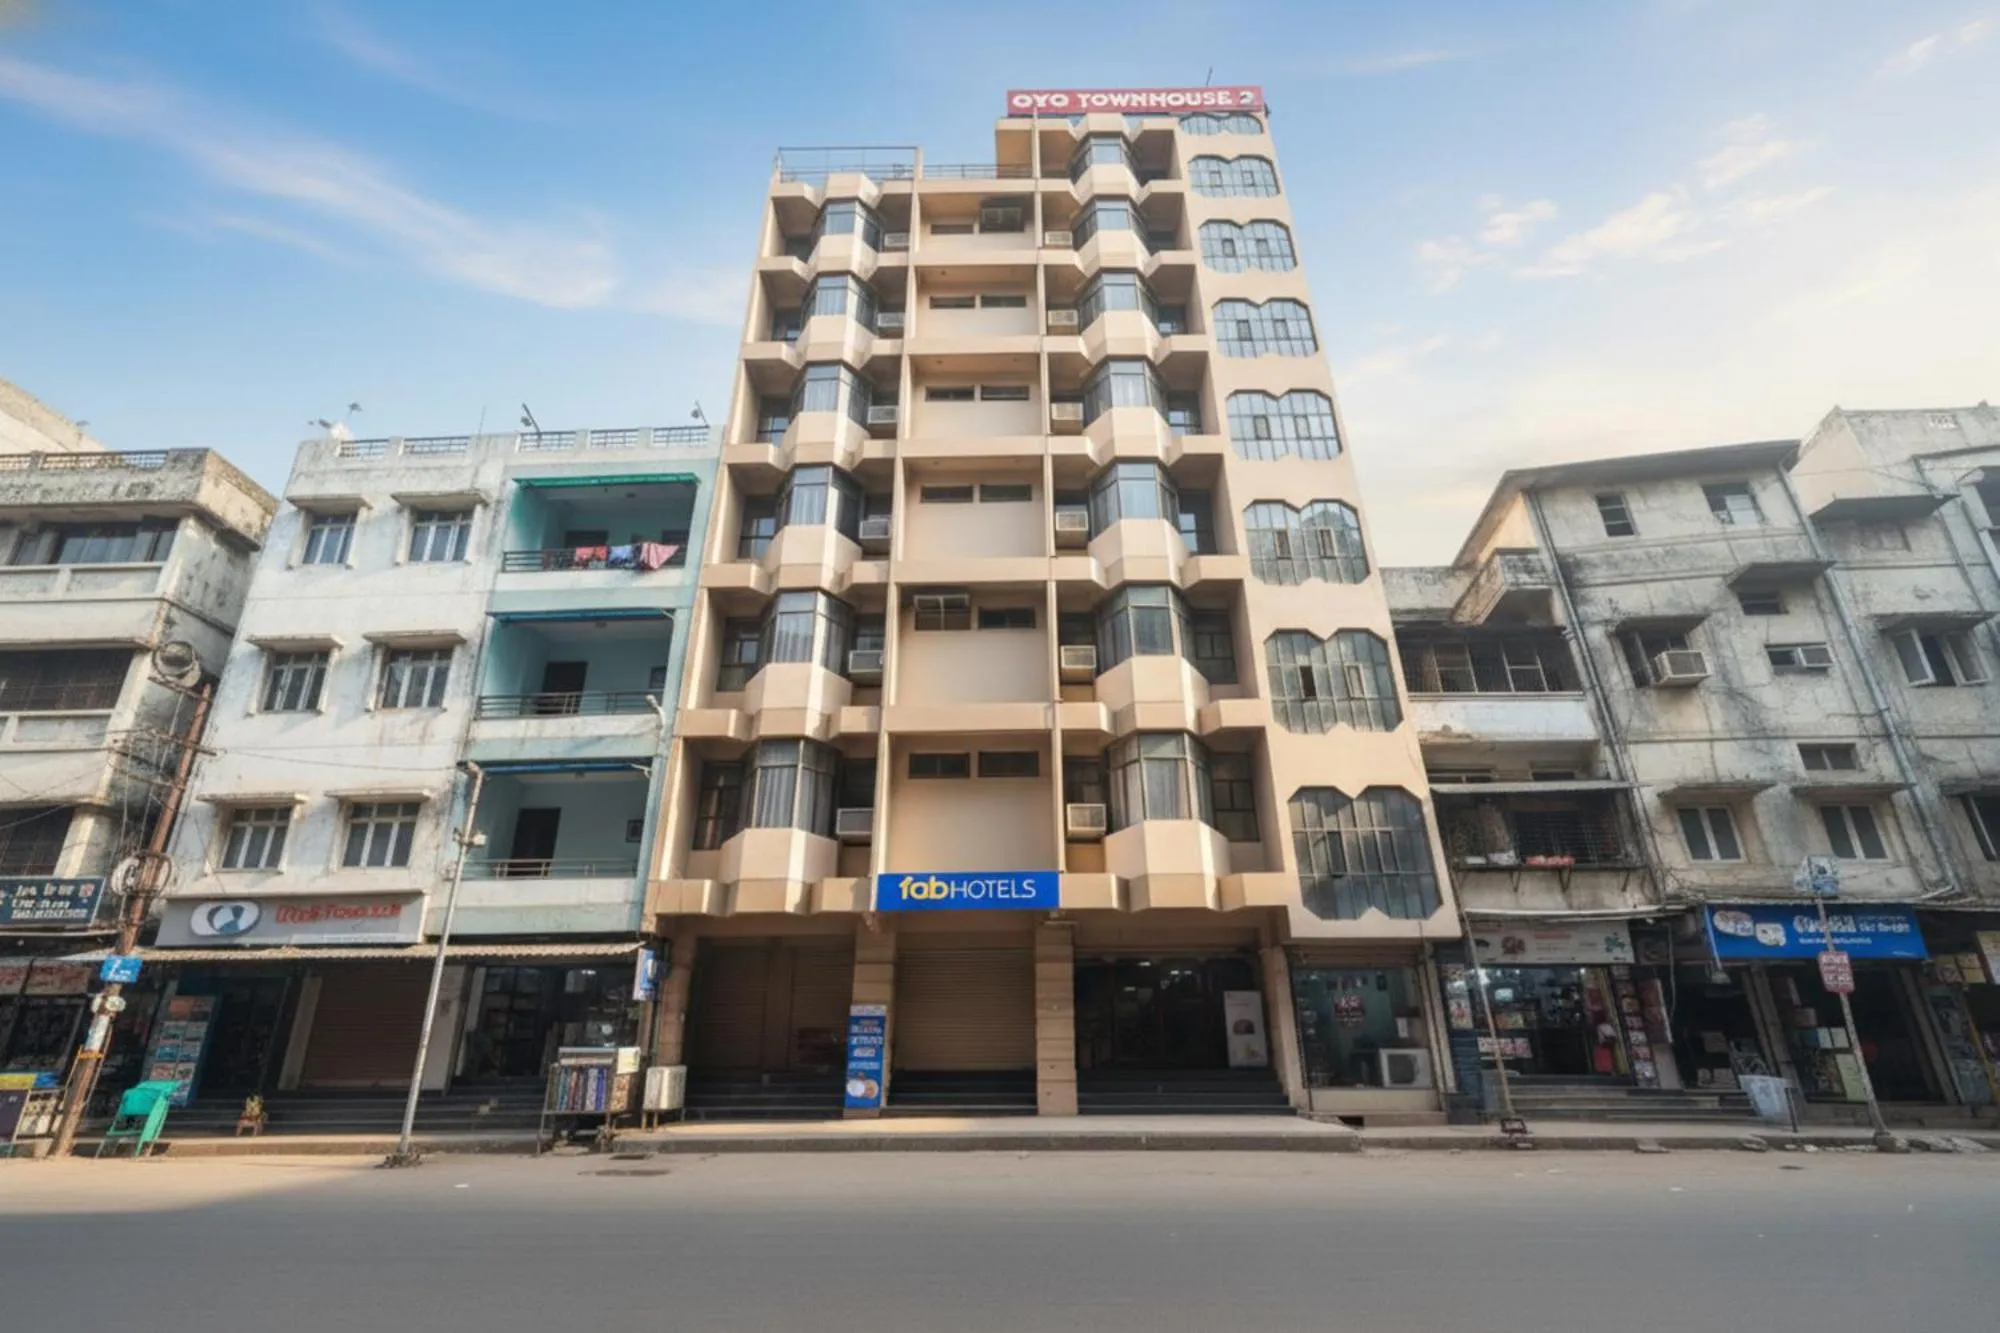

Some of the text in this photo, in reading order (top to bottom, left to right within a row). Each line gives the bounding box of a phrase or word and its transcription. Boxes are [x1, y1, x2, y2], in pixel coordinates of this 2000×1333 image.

[1012, 90, 1255, 108] OYO TOWNHOUSE 2
